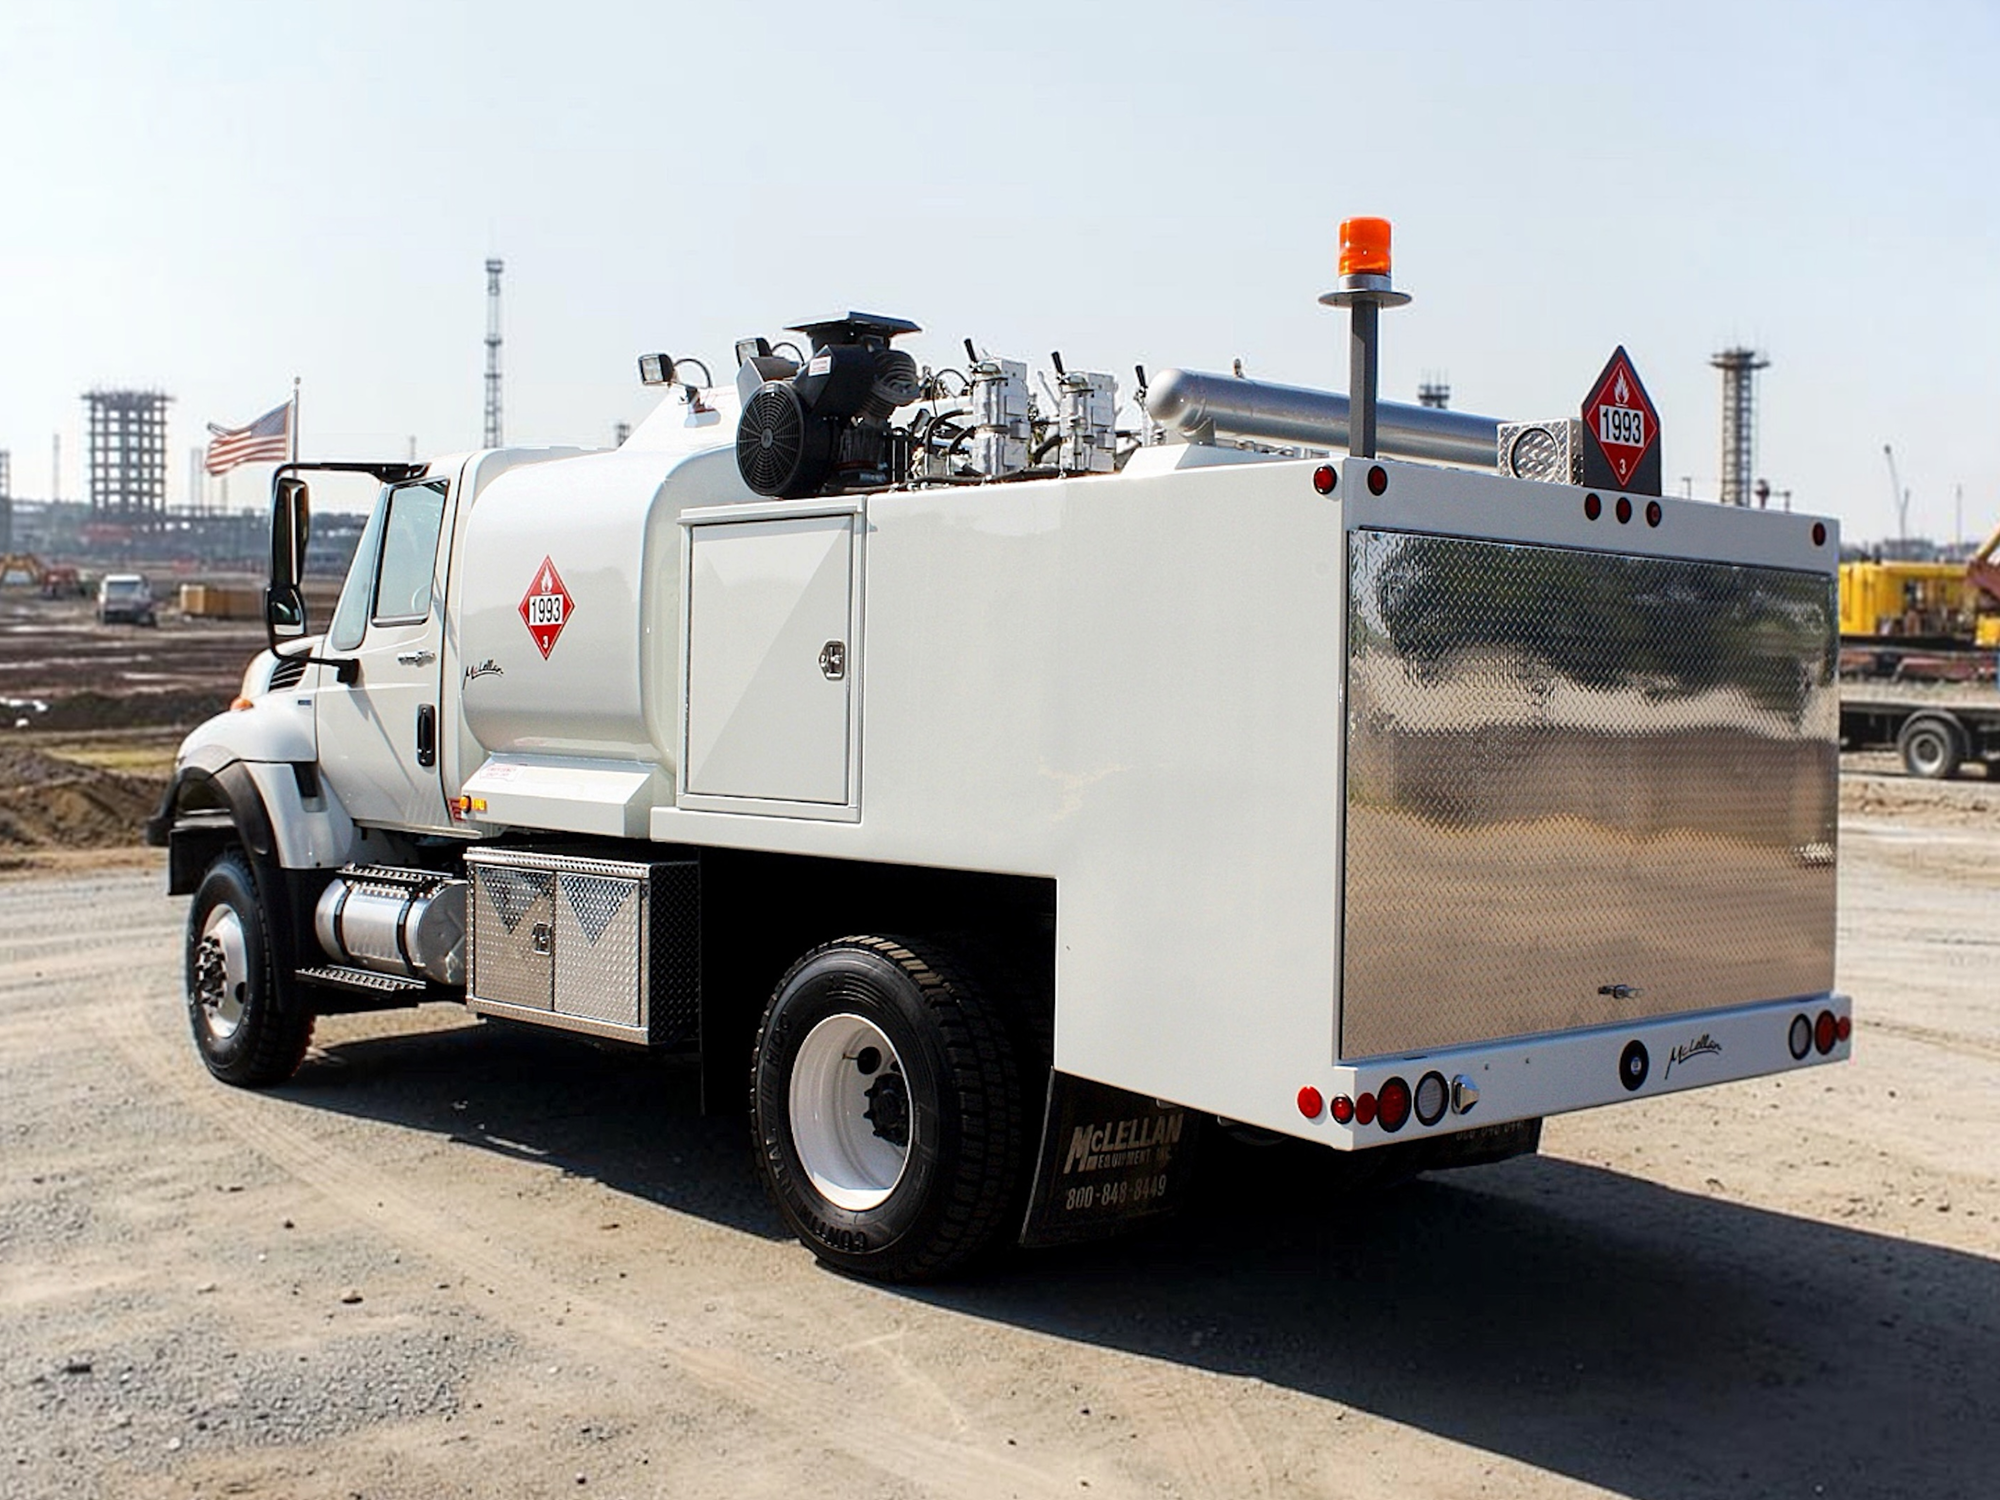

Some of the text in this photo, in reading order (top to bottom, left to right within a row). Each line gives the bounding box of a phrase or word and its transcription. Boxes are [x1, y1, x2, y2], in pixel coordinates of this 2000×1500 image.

[1602, 408, 1642, 444] 1993
[1619, 458, 1627, 475] 3
[531, 597, 562, 623] 1993
[542, 635, 550, 649] 3
[766, 1127, 869, 1253] CONTINNTAL
[1065, 1174, 1168, 1211] 800-848-8449
